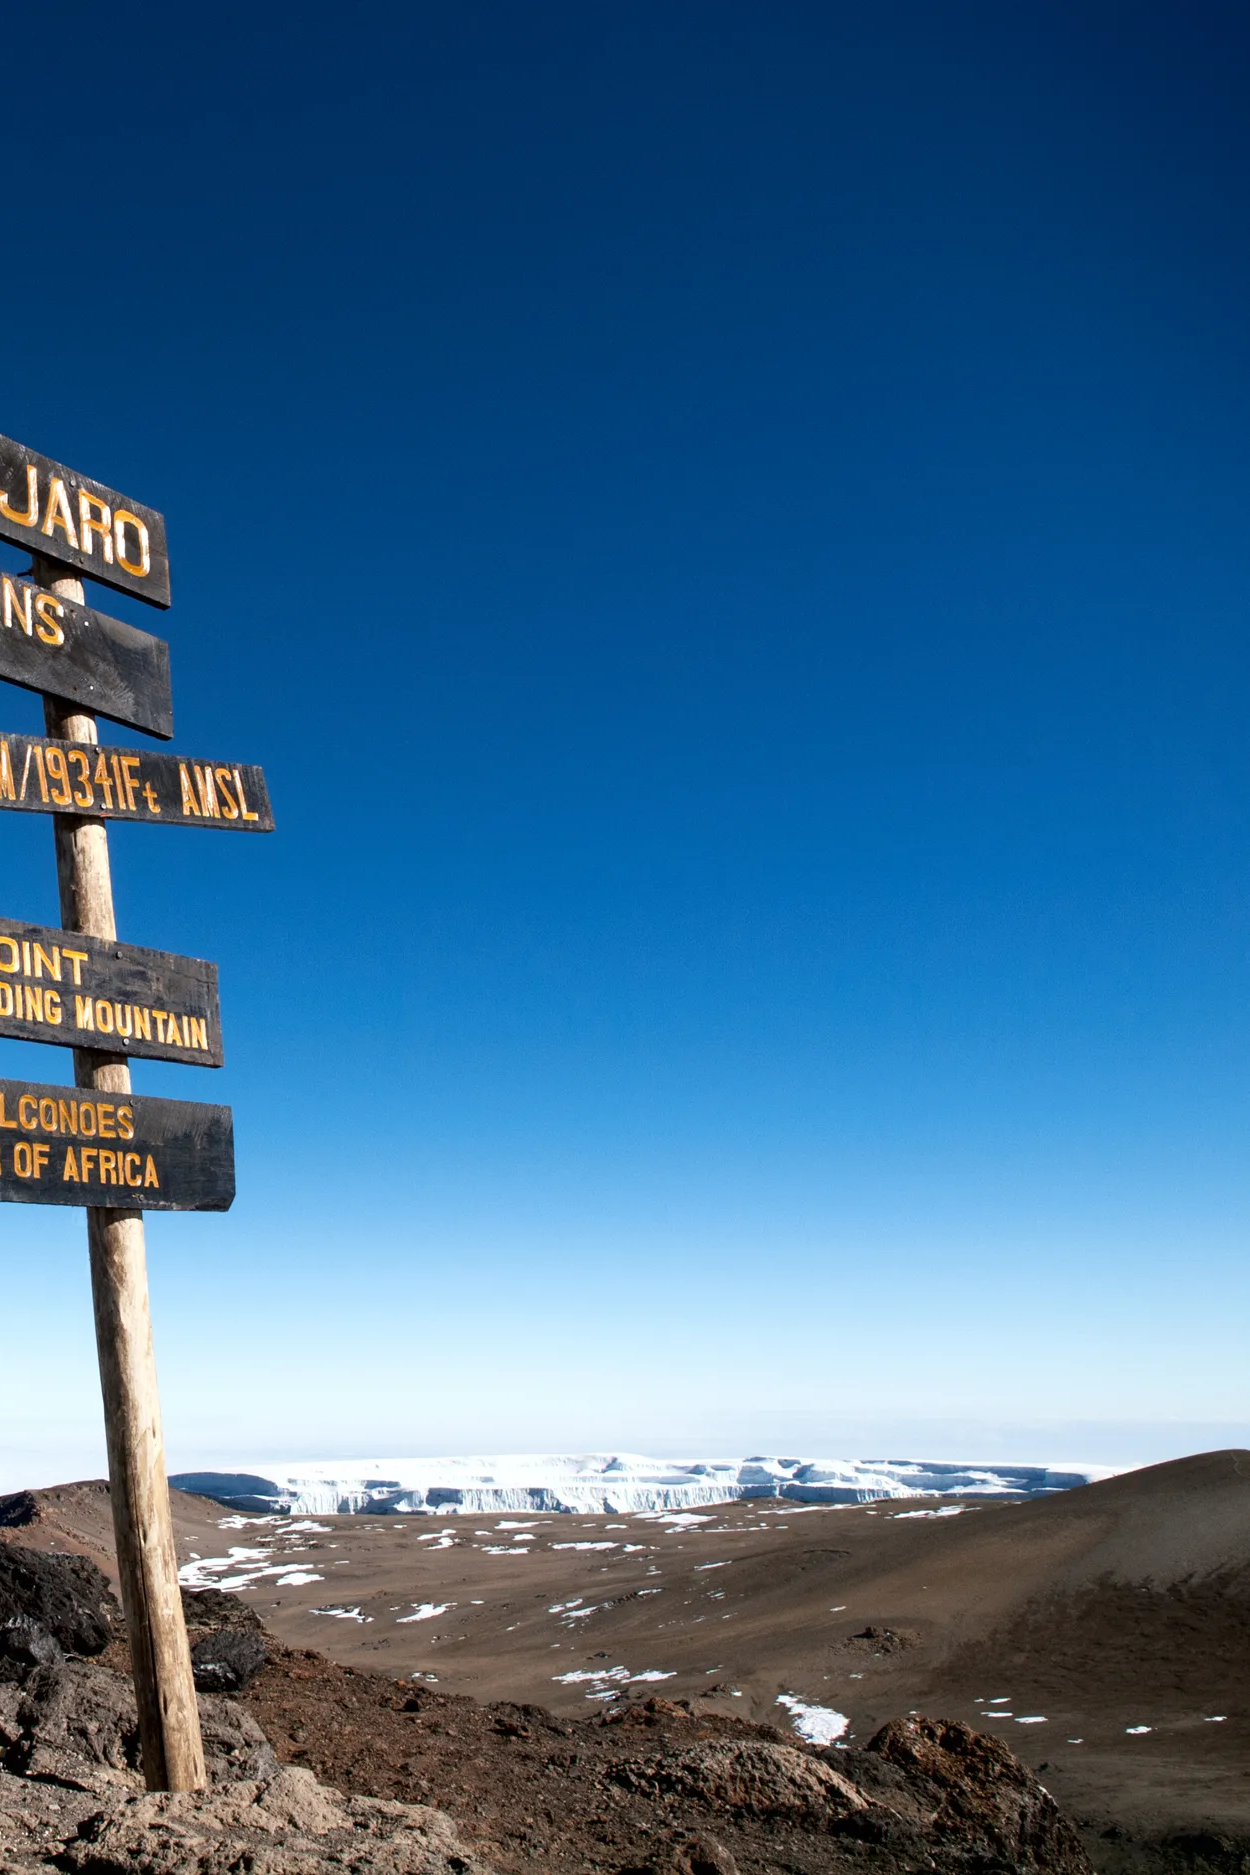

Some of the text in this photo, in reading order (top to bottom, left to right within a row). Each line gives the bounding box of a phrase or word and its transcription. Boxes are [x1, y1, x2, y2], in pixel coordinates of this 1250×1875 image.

[179, 762, 259, 822] AMSL
[75, 994, 209, 1052] MOUNTAIN
[13, 1141, 51, 1180] OF
[62, 1145, 160, 1189] AFRICA
